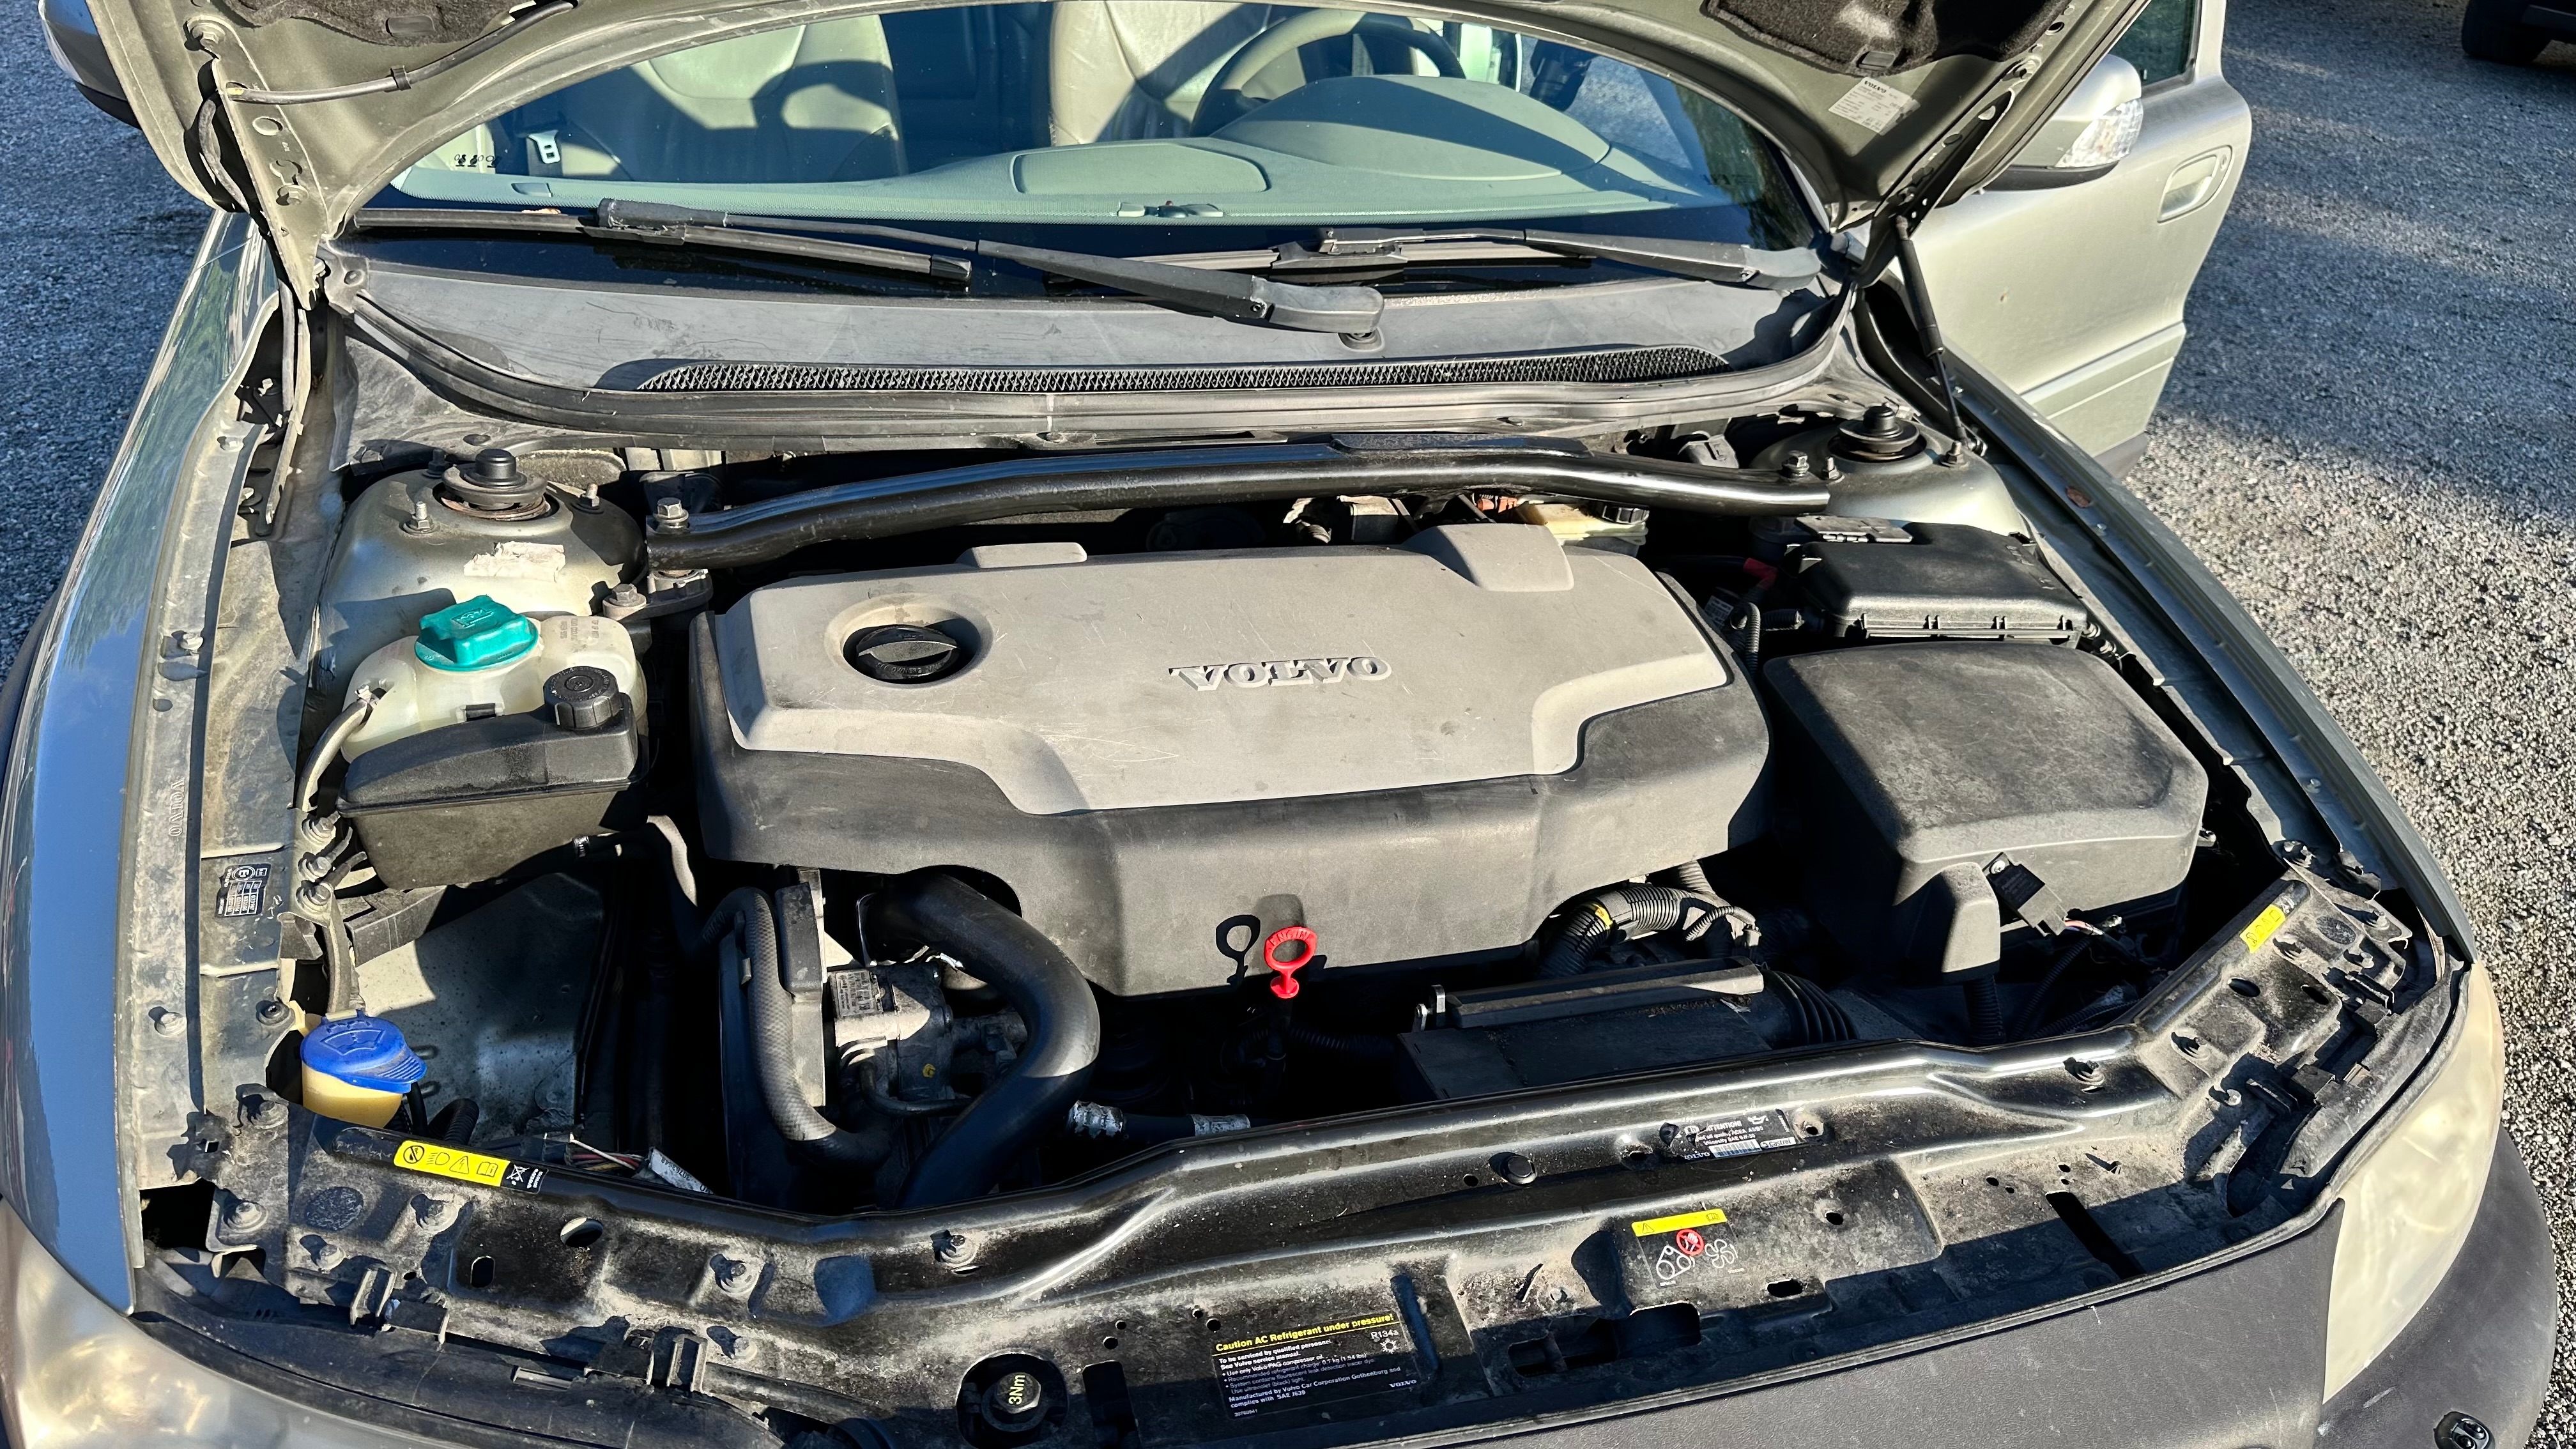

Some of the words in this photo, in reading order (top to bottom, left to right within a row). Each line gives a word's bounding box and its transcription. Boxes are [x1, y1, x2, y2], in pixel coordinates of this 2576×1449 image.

[1169, 656, 1392, 691] VOLVO
[169, 777, 185, 837] VOLVO
[1768, 1138, 1791, 1147] Castrol
[1216, 1339, 1253, 1351] Caution
[1255, 1336, 1268, 1344] AC
[1270, 1326, 1322, 1342] Refrigerant
[1324, 1322, 1349, 1332] under
[1352, 1314, 1393, 1328] pressure!
[1370, 1330, 1399, 1340] R134a
[1238, 1351, 1262, 1360] serviced
[1273, 1344, 1300, 1354] qualified
[1301, 1339, 1332, 1349] personnel.
[1276, 1351, 1301, 1360] manual.
[1282, 1357, 1315, 1366] compressor
[1228, 1371, 1270, 1382] Recommended
[1271, 1366, 1300, 1376] refrigerant
[1009, 1375, 1025, 1405] 3Nm
[1229, 1390, 1272, 1402] Manufactured
[1313, 1376, 1350, 1386] Corporation
[1245, 1383, 1271, 1392] ultraviolet
[1389, 1379, 1417, 1388] VOLVO
[1230, 1399, 1259, 1408] complies
